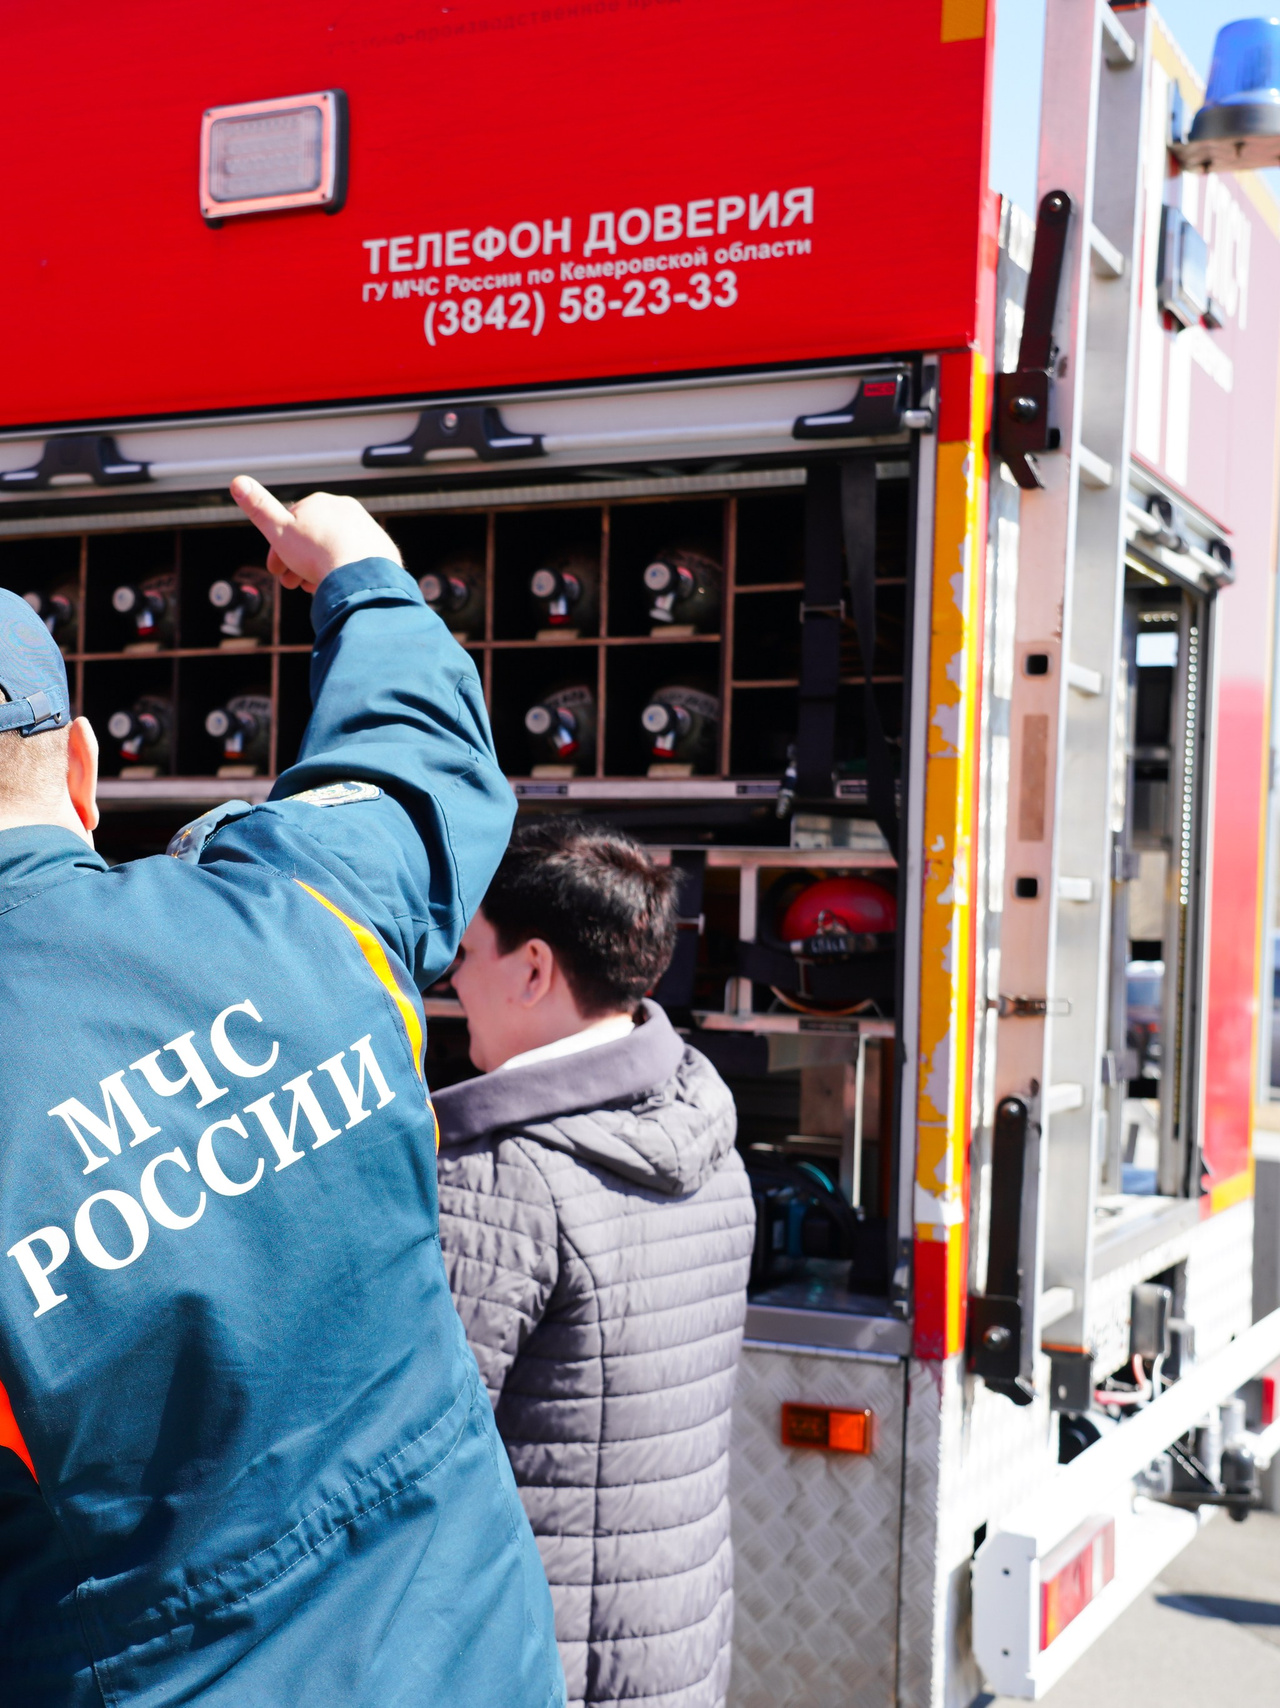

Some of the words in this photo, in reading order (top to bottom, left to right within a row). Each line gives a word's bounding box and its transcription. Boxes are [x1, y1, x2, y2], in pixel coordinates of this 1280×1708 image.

[362, 216, 572, 275] ТЕЛЕФОН
[583, 186, 815, 257] ДОВЕРИЯ
[362, 282, 388, 302] ГУ
[392, 276, 439, 299] МЧС
[445, 272, 522, 294] России
[527, 268, 555, 285] по
[560, 245, 708, 281] Кемеровской
[714, 238, 812, 264] области
[423, 291, 545, 346] (3842)
[558, 269, 738, 324] 58-23-33
[47, 999, 279, 1175] МЧС
[7, 1033, 396, 1318] РОССИИ
